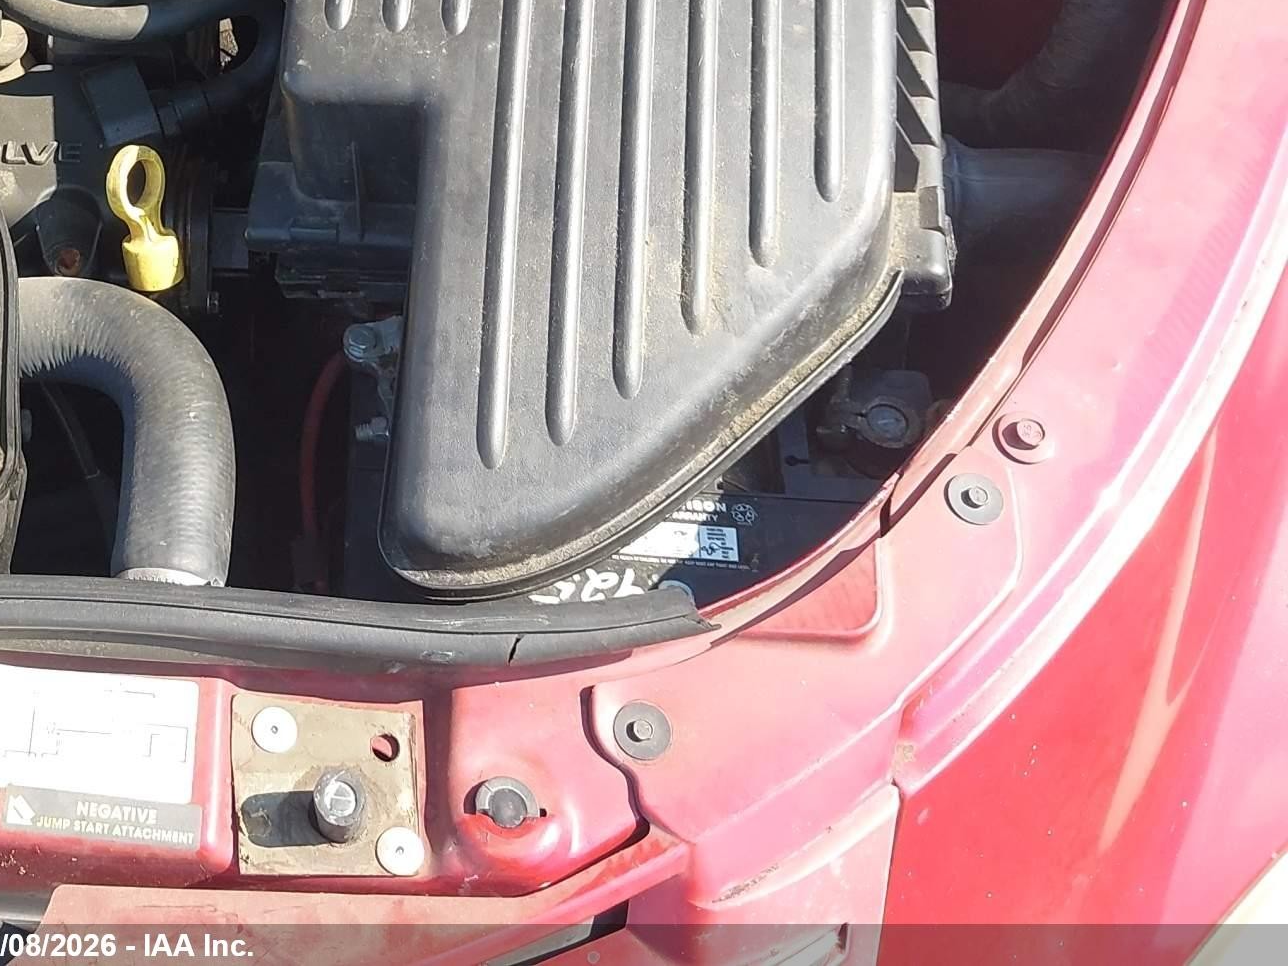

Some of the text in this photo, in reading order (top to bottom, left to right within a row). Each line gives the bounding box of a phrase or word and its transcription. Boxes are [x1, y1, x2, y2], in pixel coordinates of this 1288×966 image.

[76, 801, 158, 825] NEGATIVE
[37, 815, 195, 845] JUMP START ATTACHMENT
